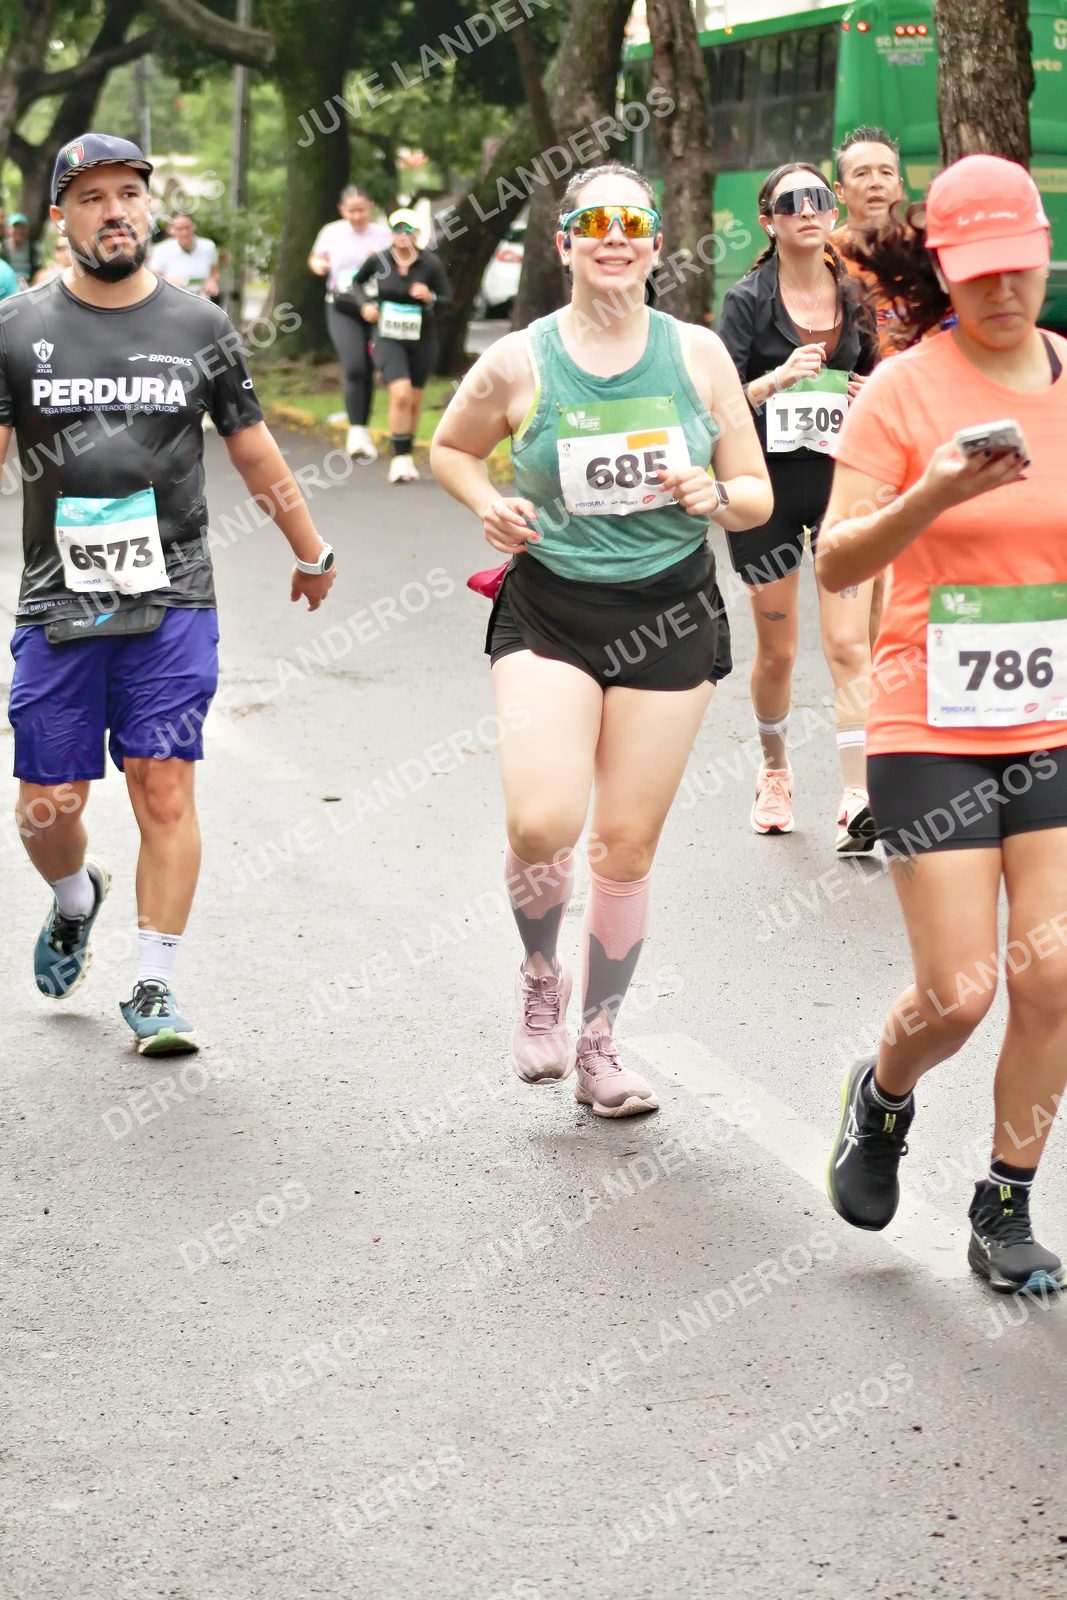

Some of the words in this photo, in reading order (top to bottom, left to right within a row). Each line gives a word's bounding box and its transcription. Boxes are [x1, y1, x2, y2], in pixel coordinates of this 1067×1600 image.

[148, 354, 193, 366] BROOKS
[32, 377, 187, 406] PERDURA
[86, 404, 139, 412] JUNTEADORES
[144, 404, 179, 413] ESTUCOS
[776, 407, 843, 434] 1309
[585, 450, 668, 490] 685
[70, 537, 153, 571] 6573
[959, 647, 1053, 691] 786
